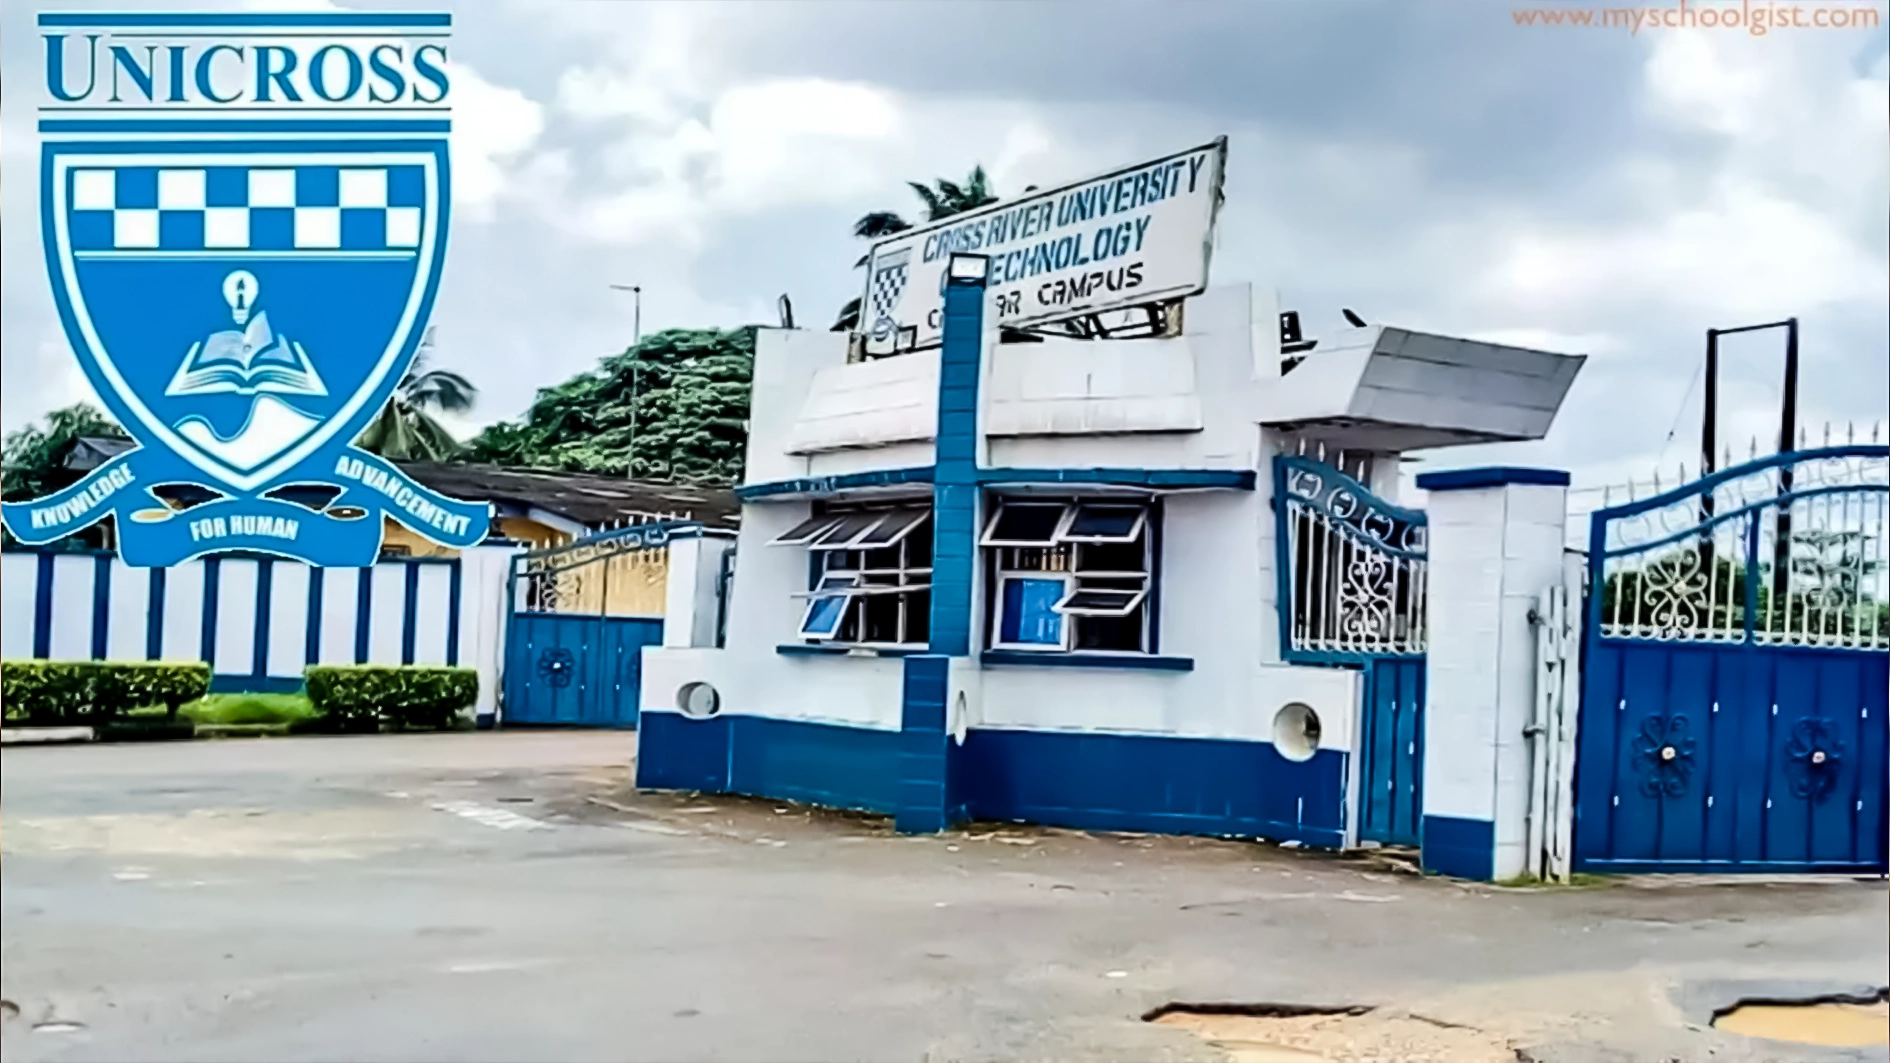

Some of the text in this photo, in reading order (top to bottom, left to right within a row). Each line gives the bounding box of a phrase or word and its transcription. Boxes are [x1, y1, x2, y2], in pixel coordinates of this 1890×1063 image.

[923, 154, 1205, 263] CROSS RIVER UNIVERSITY
[986, 215, 1151, 286] ECHNOLOGY
[1038, 262, 1144, 305] CAMPUS
